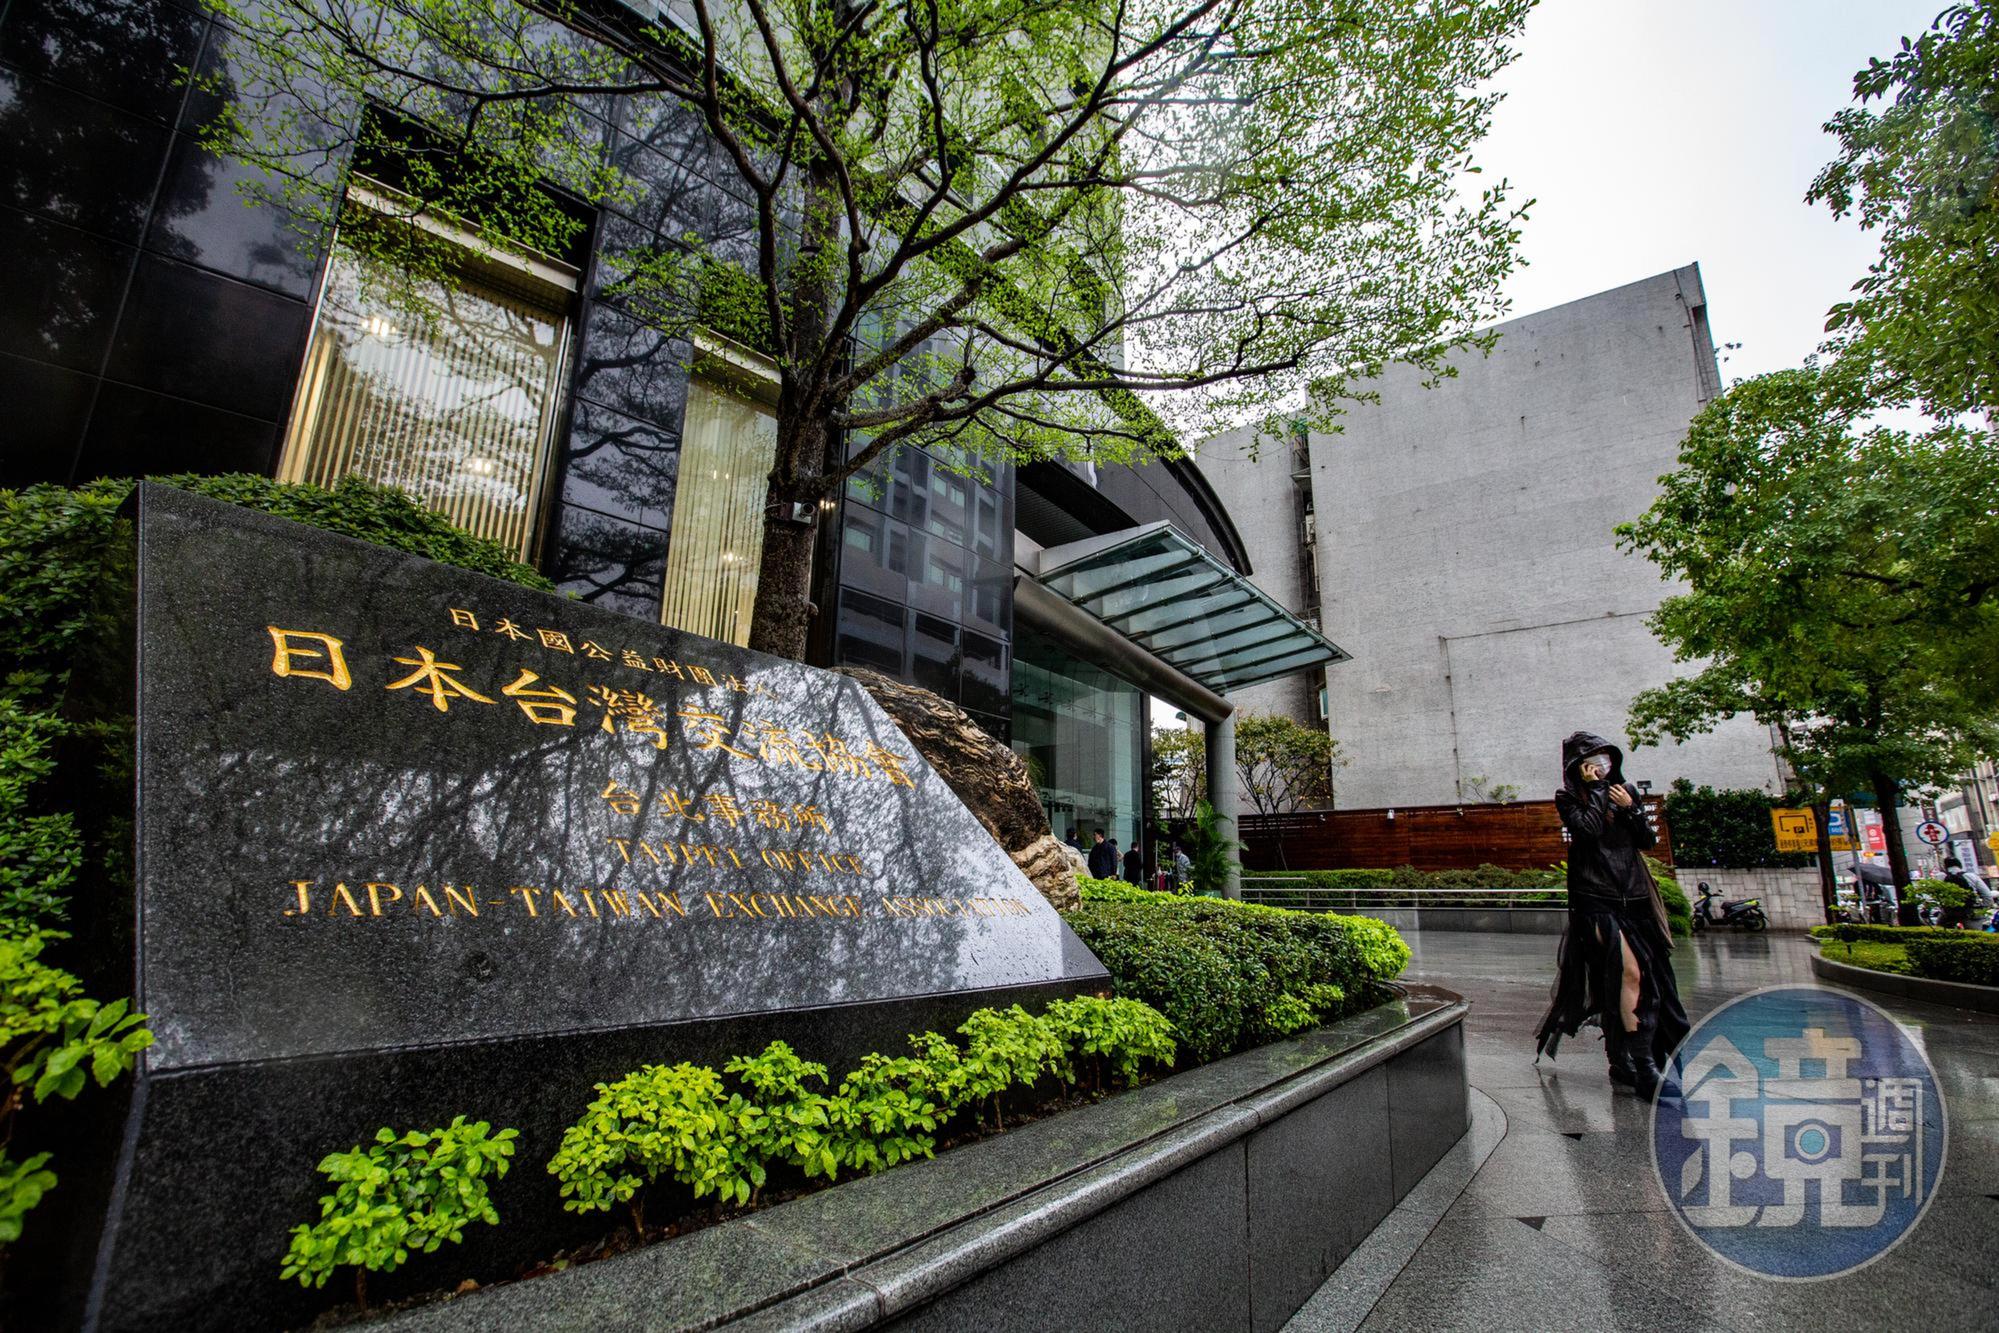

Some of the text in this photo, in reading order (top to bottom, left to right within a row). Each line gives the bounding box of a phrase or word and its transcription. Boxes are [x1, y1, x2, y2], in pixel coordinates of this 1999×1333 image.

[267, 626, 916, 791] 日本台灣交流協會
[601, 780, 832, 836] 台北事務所
[607, 837, 864, 875] TAIPEI OFFICE
[705, 891, 863, 919] EXCHANGE
[881, 896, 1033, 918] ASSOCIATION
